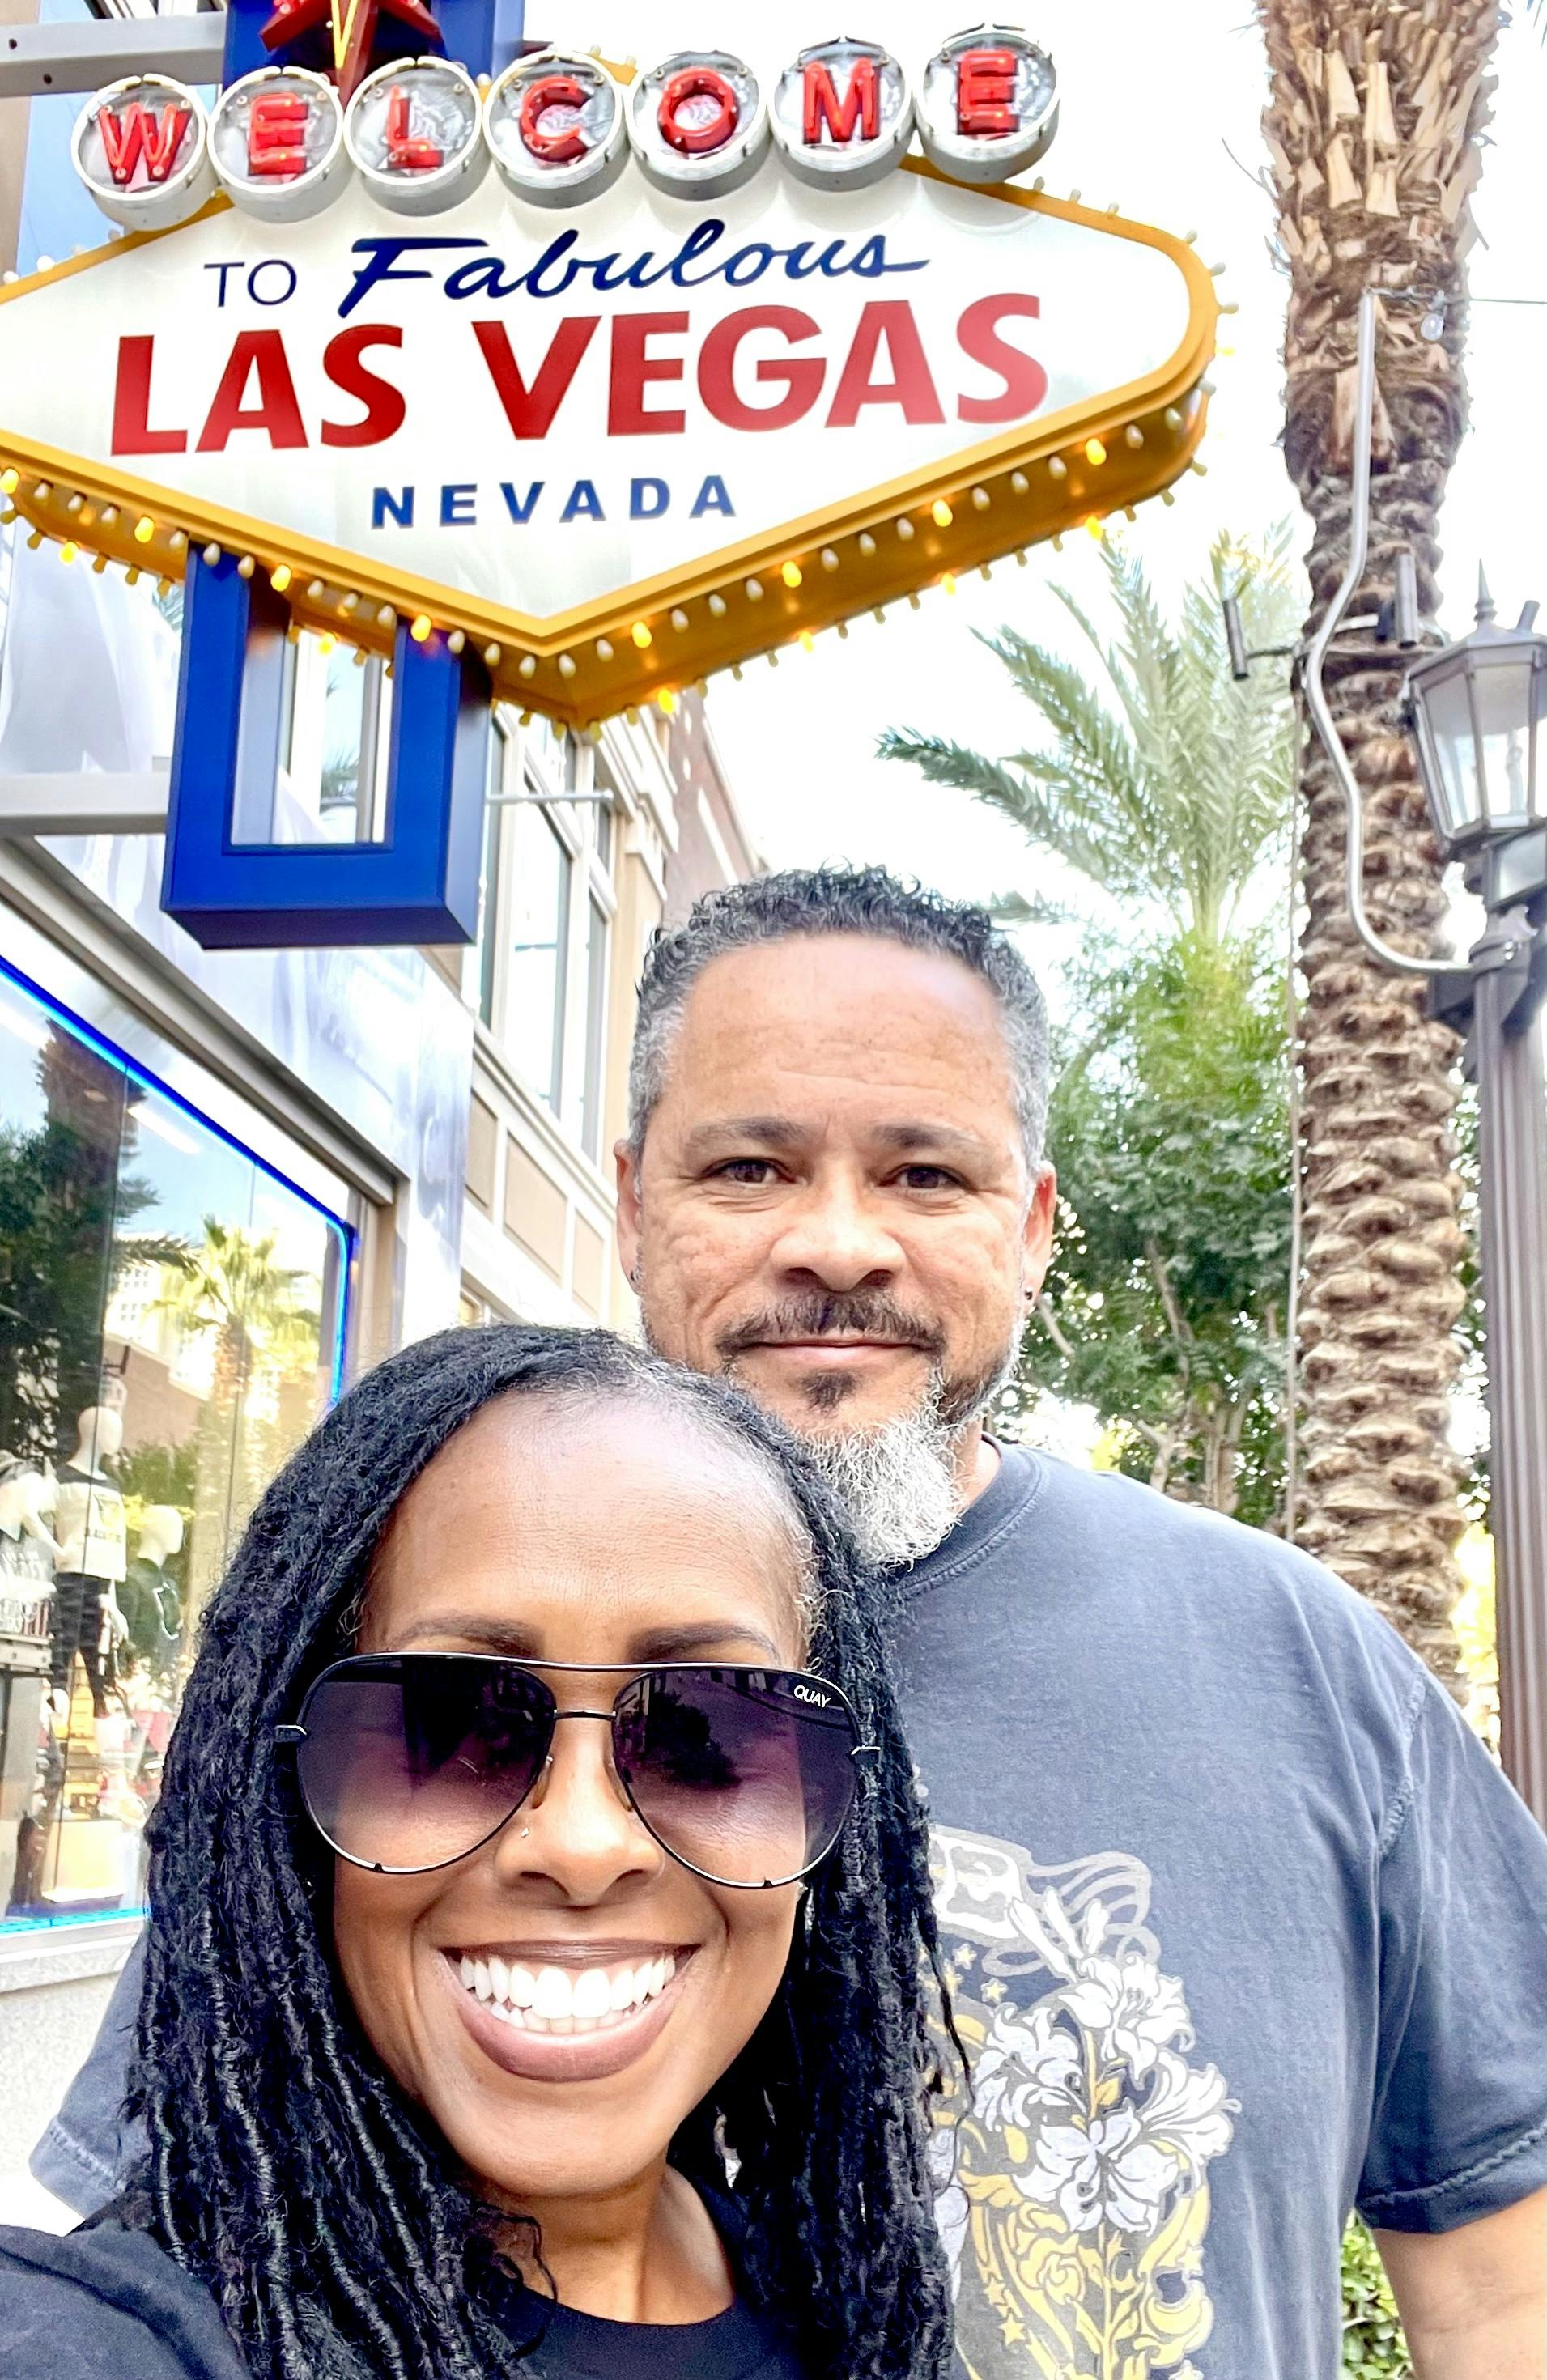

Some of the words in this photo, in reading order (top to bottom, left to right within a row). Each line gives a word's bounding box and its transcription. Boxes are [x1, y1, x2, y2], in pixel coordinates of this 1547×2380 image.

[99, 47, 1018, 186] WELCOME
[204, 260, 297, 307] TO
[338, 219, 930, 318] Fabulous
[111, 322, 406, 457] LAS
[471, 293, 1048, 440] VEGAS
[372, 474, 736, 530] NEVADA
[794, 1685, 831, 1708] QUAY
